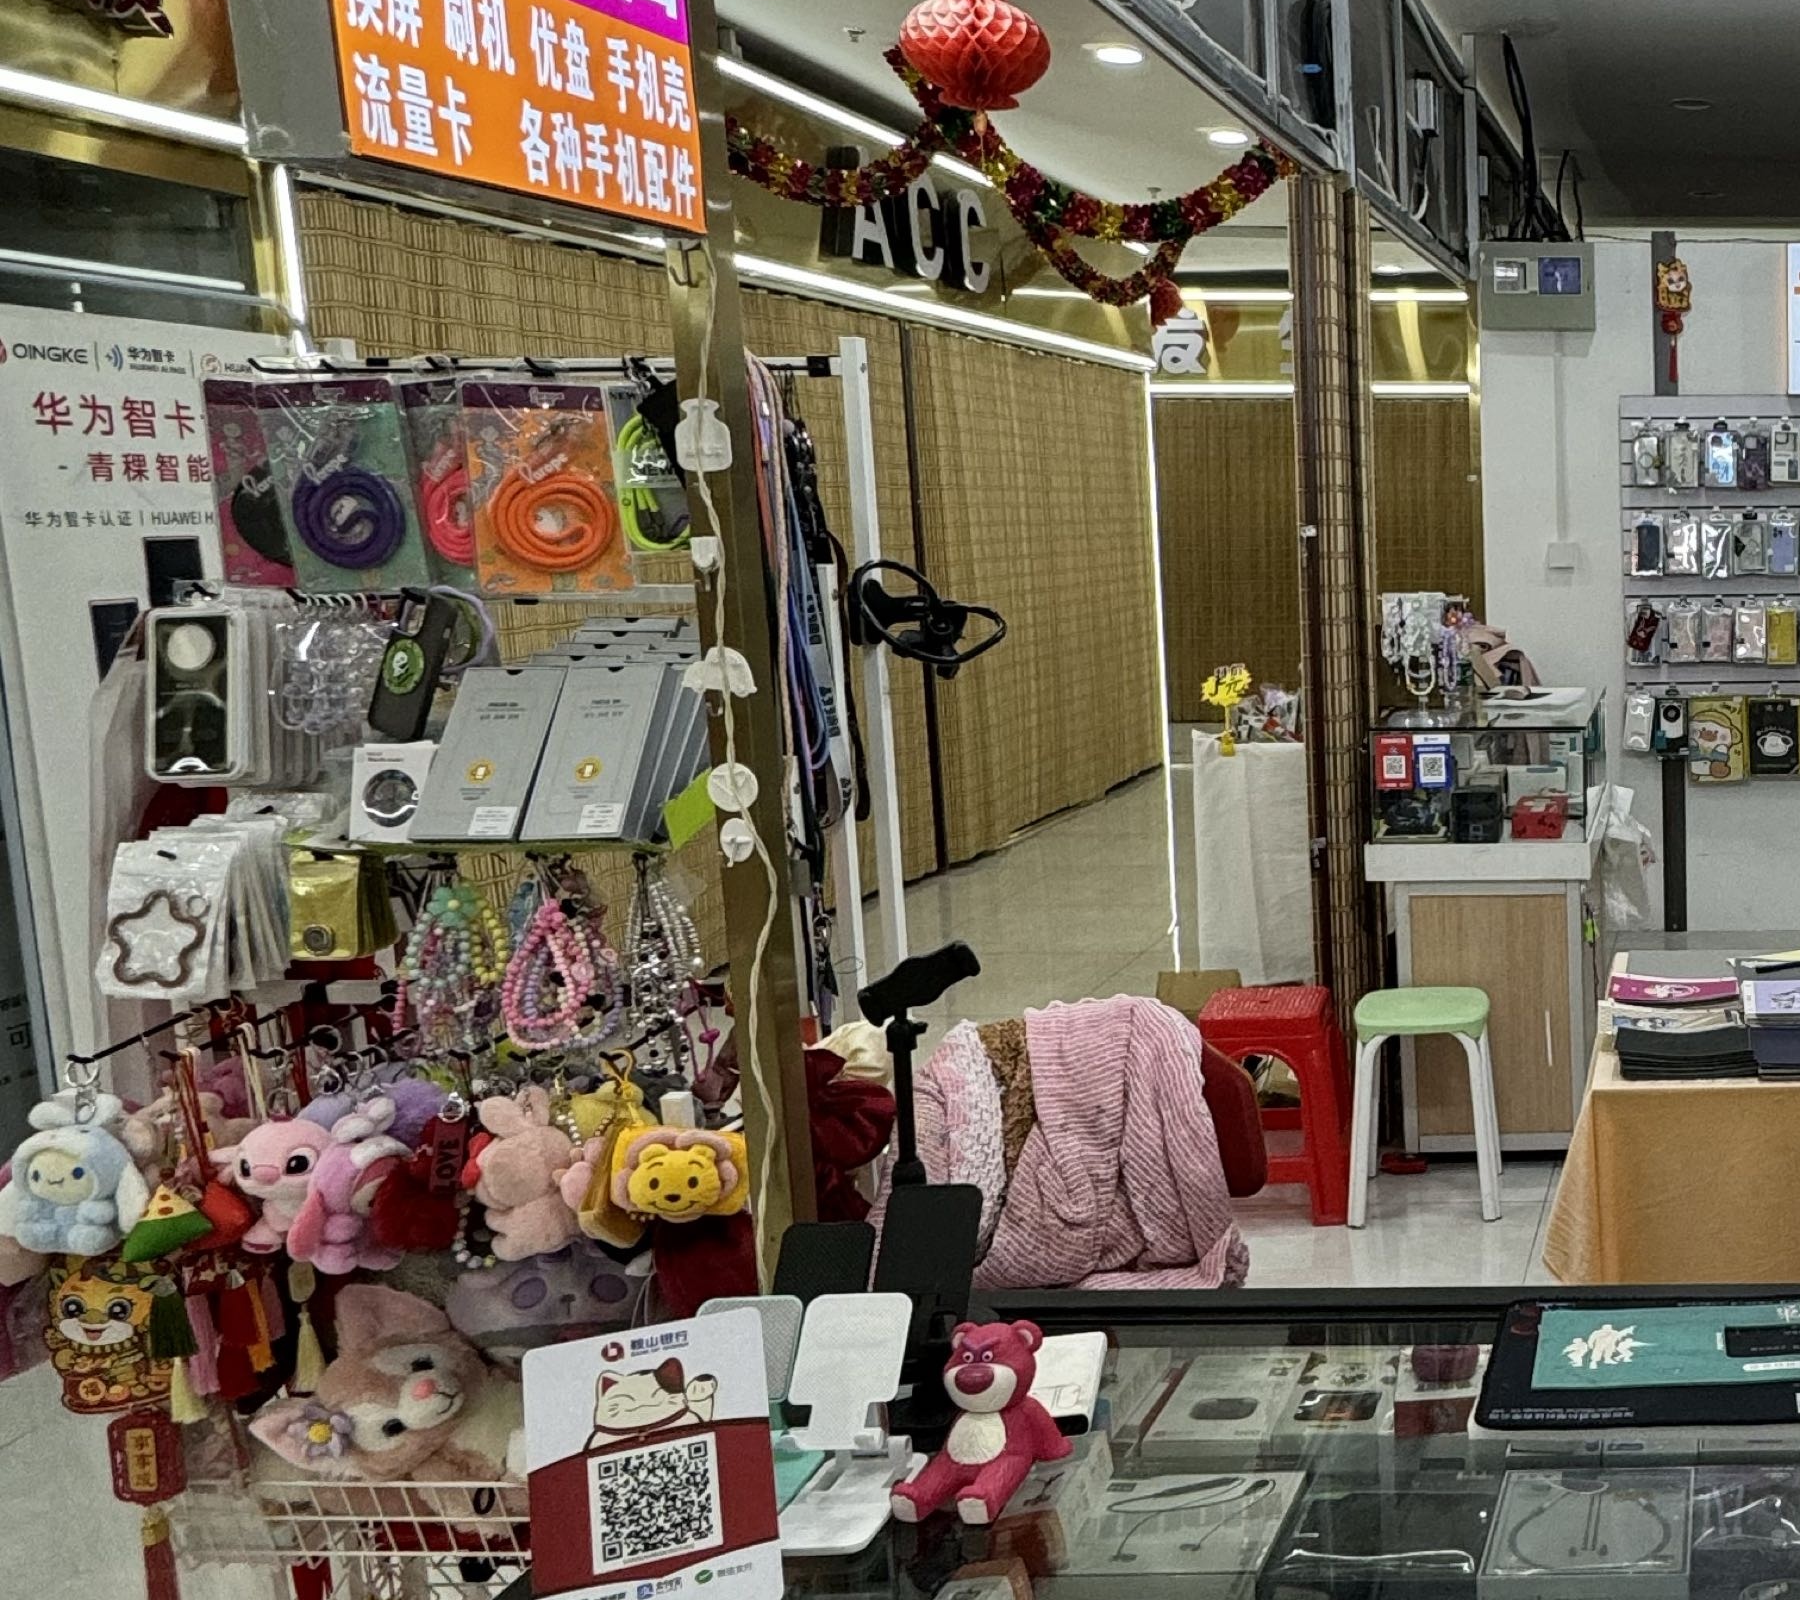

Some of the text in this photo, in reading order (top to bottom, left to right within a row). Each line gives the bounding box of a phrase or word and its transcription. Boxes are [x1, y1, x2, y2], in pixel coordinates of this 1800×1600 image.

[529, 4, 595, 101] 优盘
[606, 37, 691, 132] 手机壳
[353, 51, 697, 220] 流量卡 各种手机配件
[33, 390, 196, 439] 华为智卡
[87, 451, 212, 483] 青稞智能
